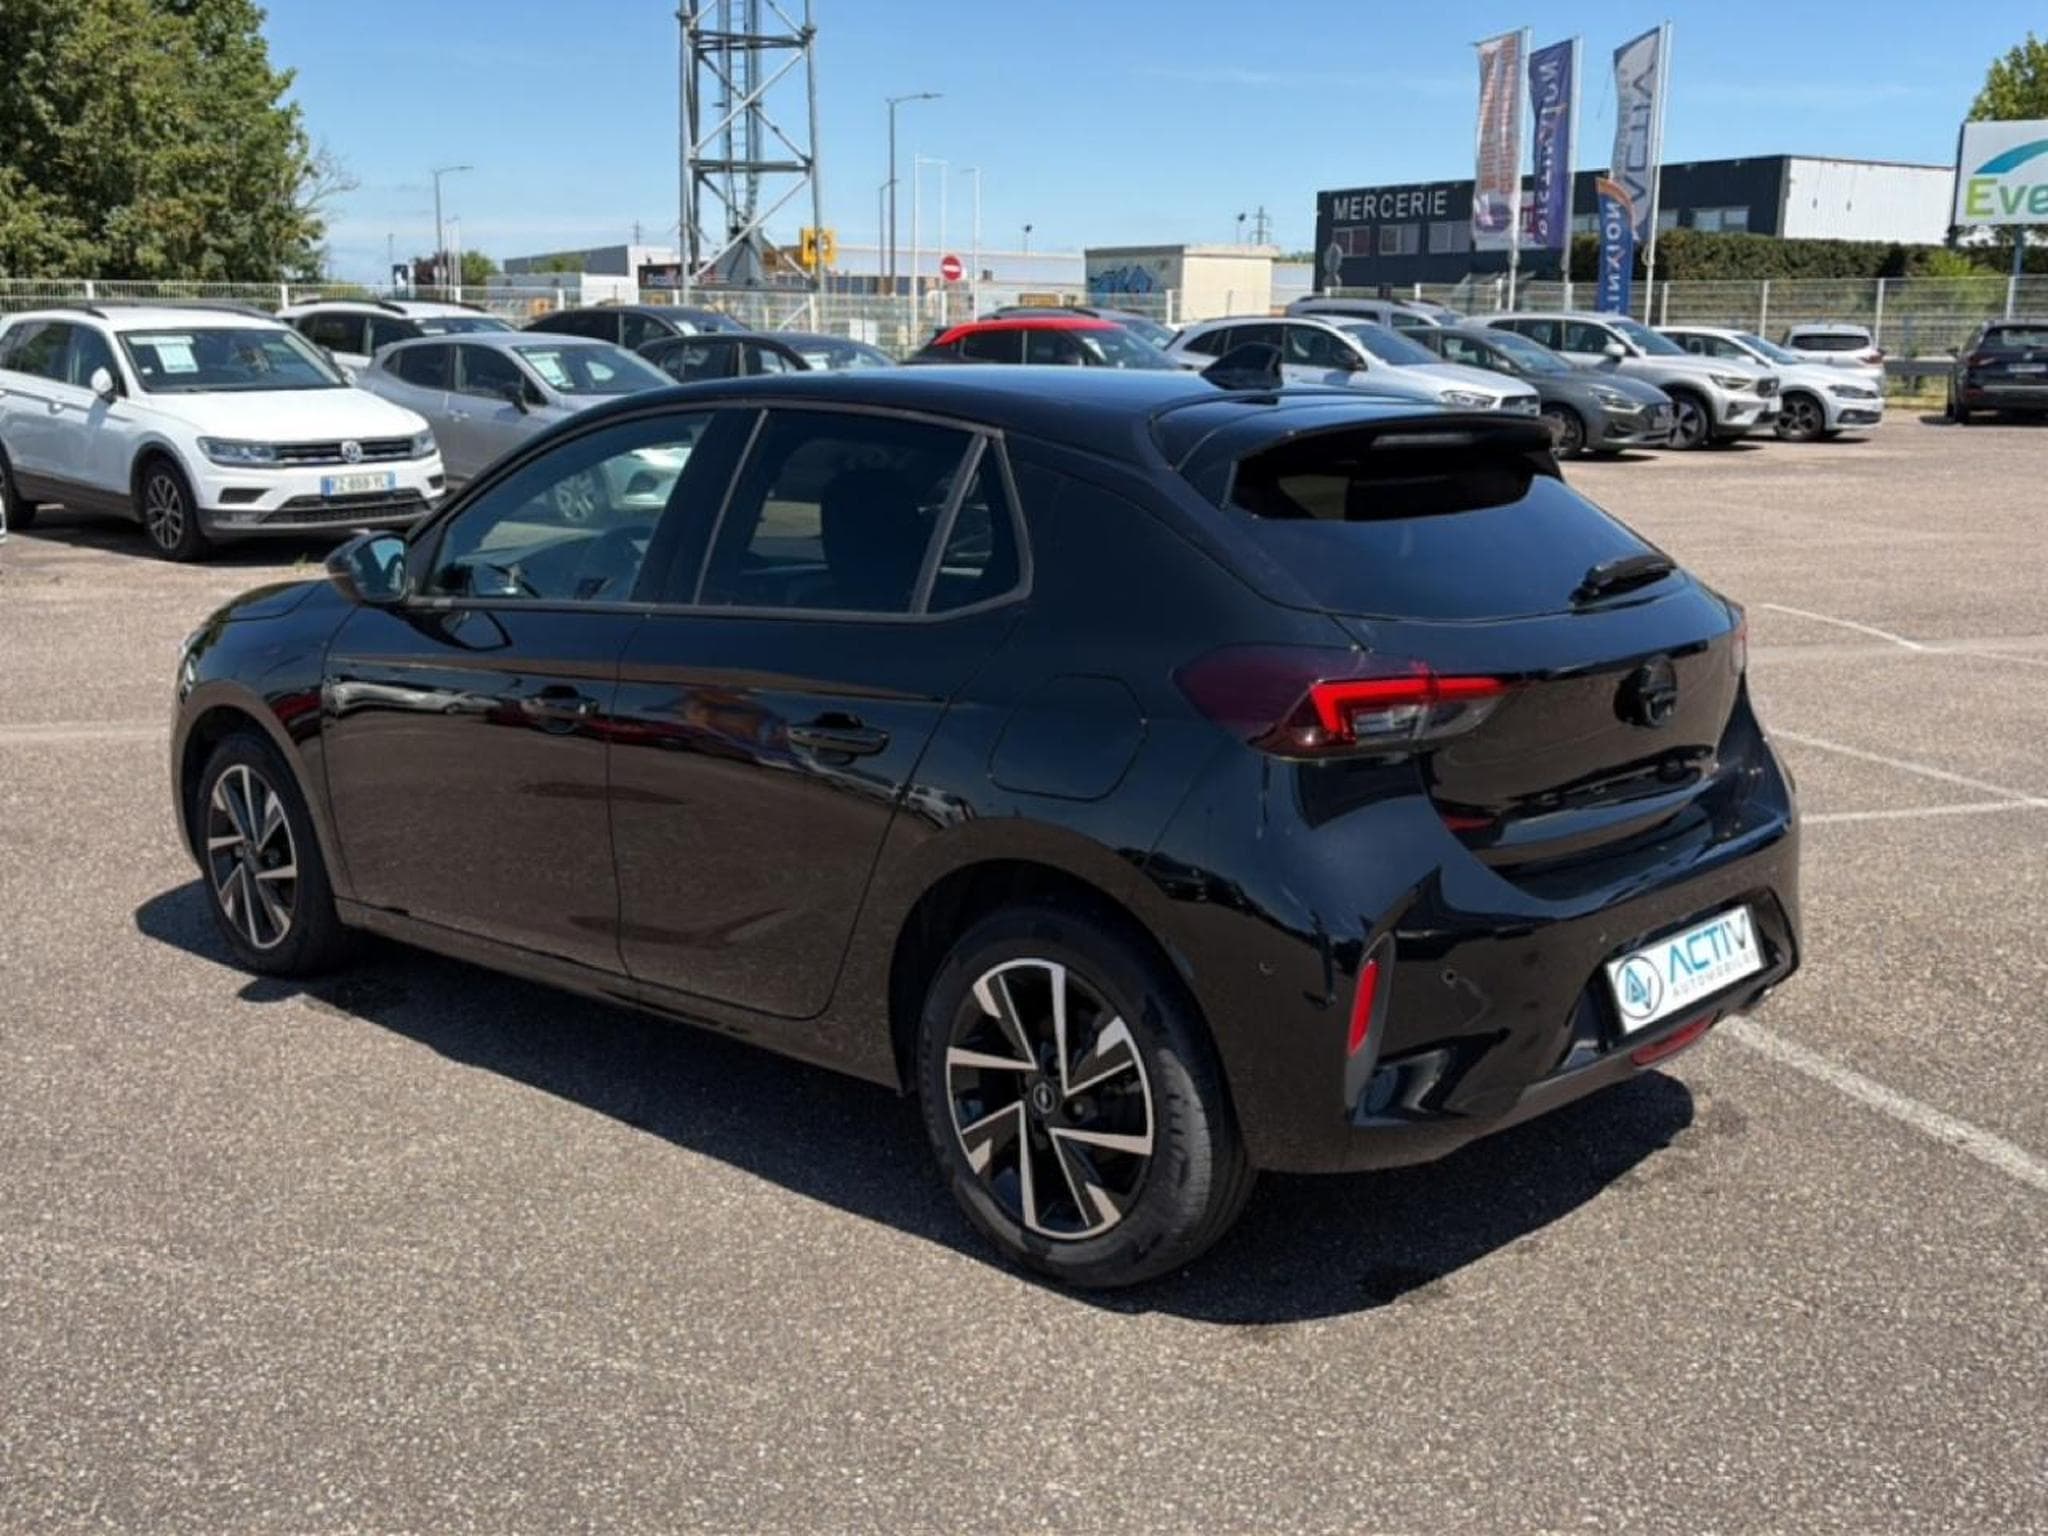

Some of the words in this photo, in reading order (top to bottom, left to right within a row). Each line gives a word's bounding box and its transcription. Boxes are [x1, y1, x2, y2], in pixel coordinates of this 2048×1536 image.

[1333, 190, 1448, 220] MERCERIE
[1966, 178, 2048, 216] Eve
[1669, 912, 1746, 985] ACTIV
